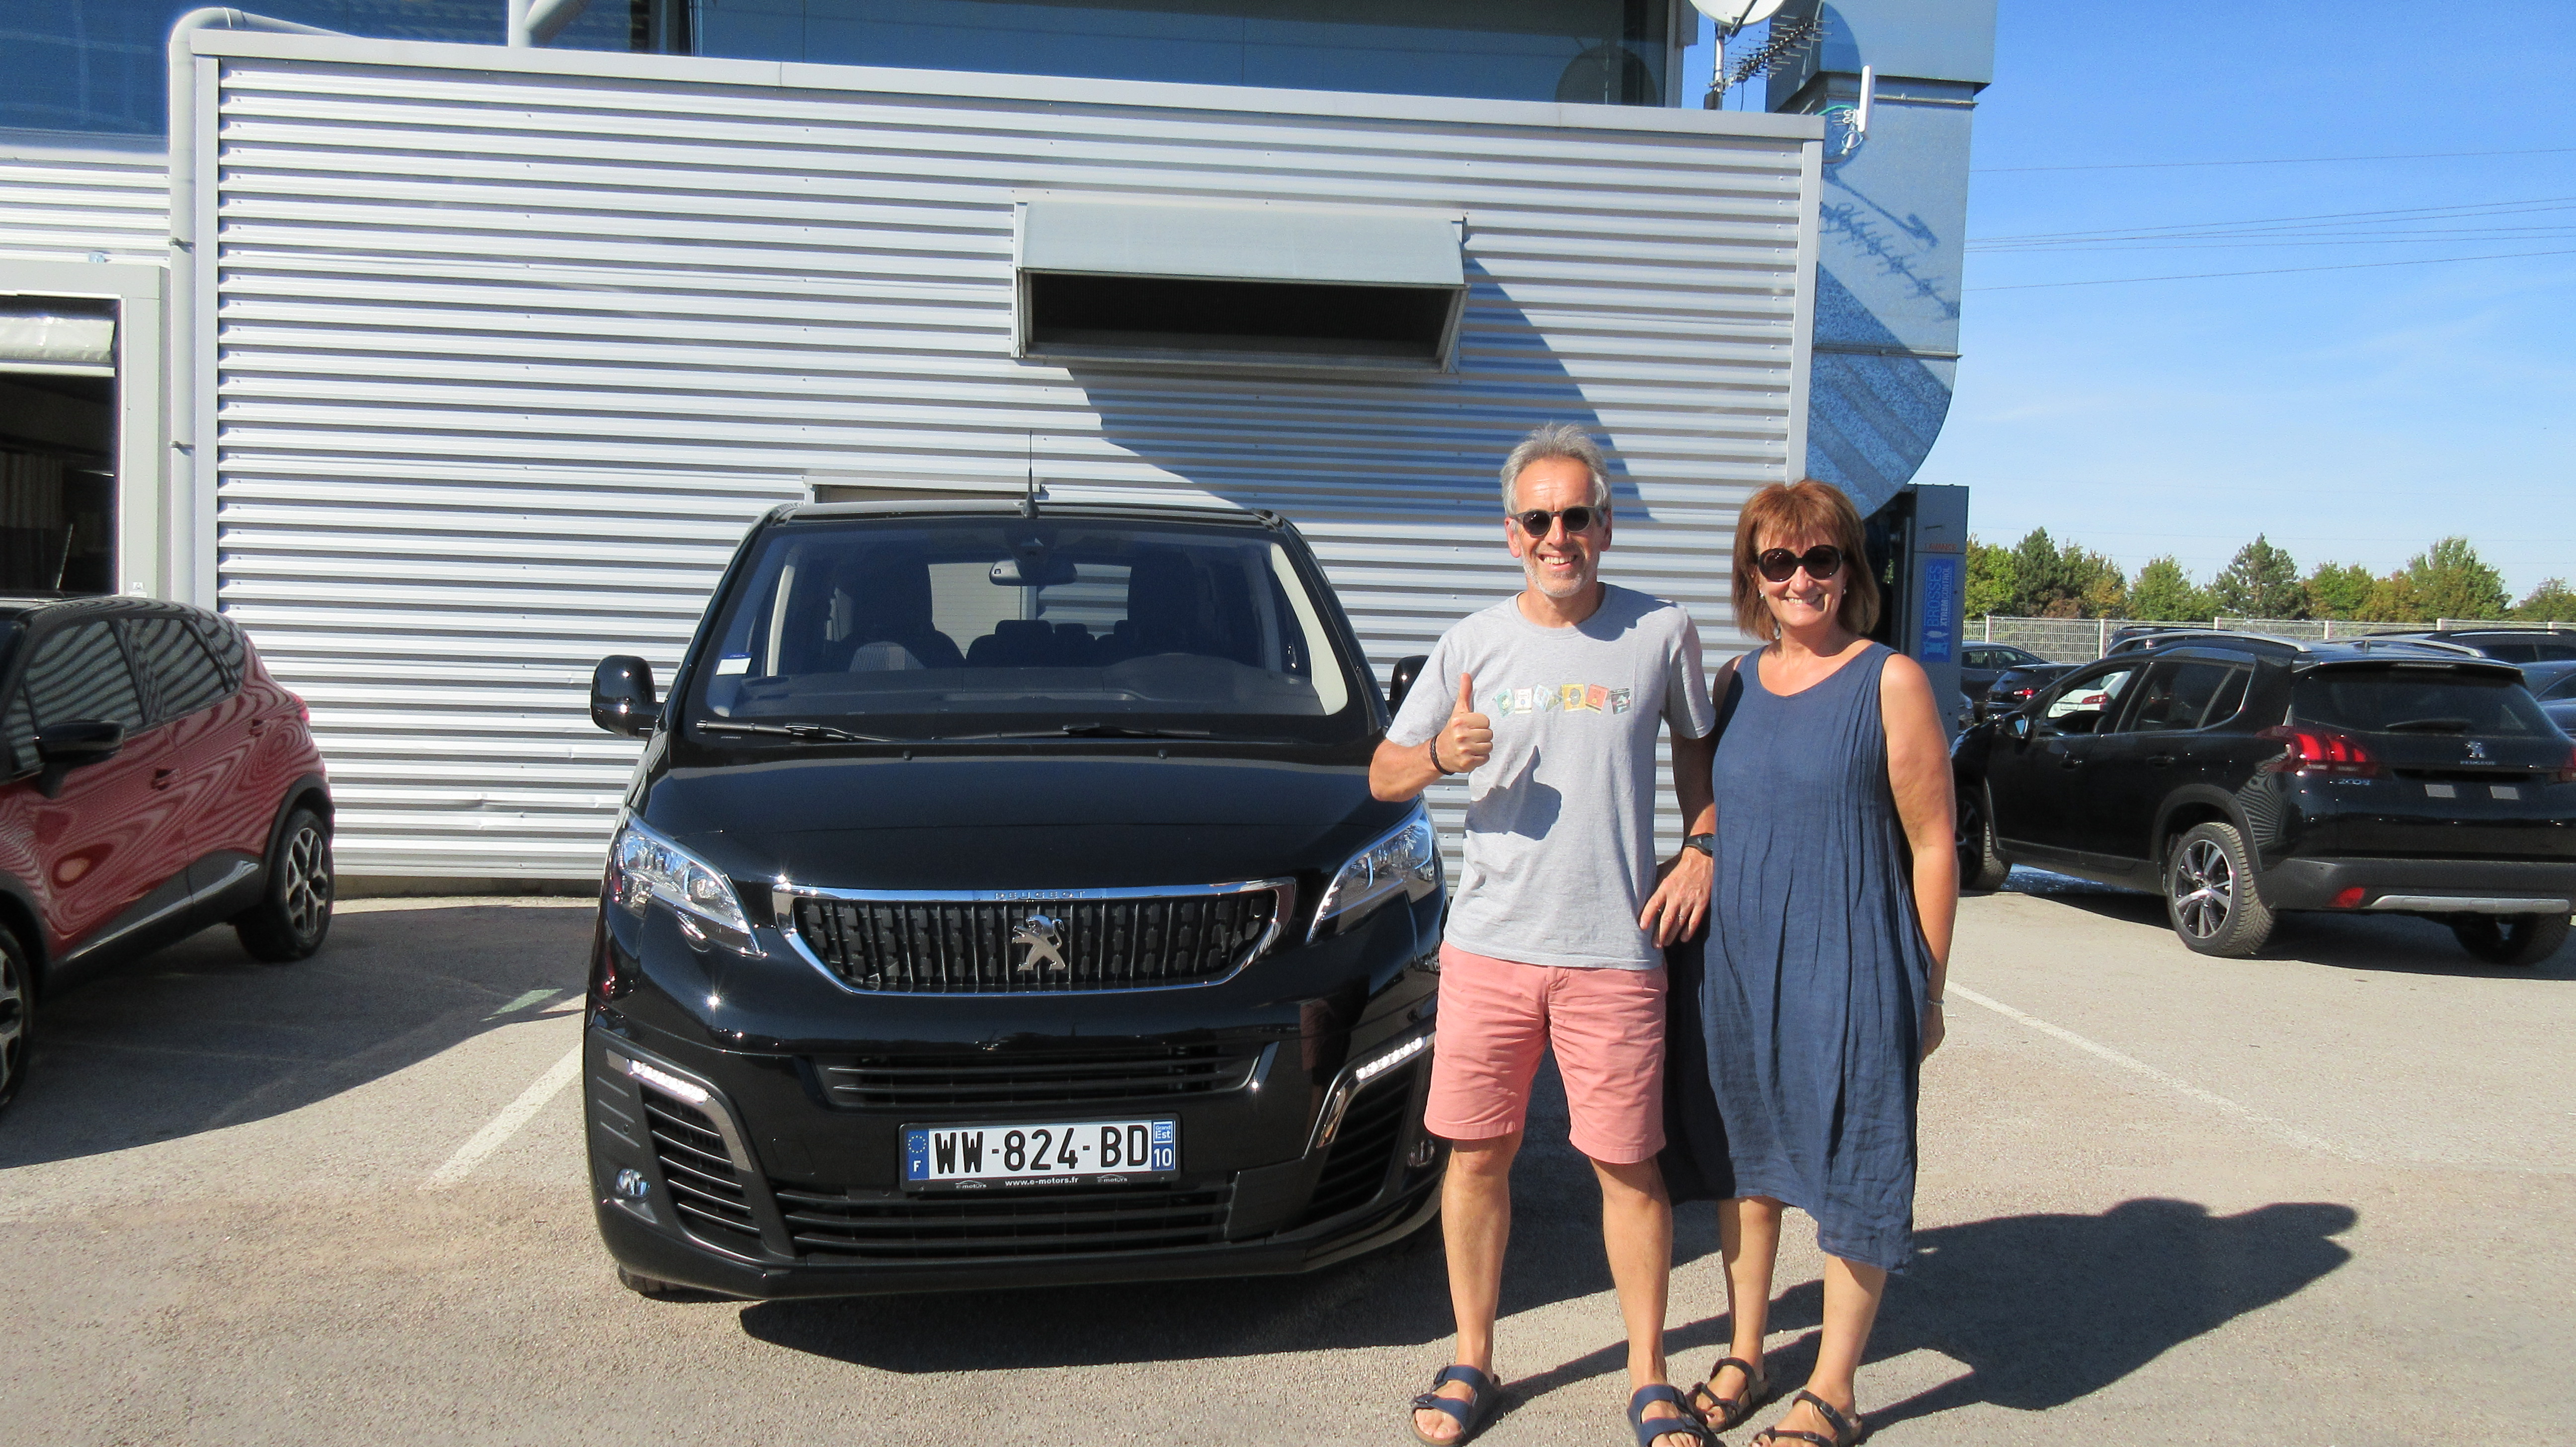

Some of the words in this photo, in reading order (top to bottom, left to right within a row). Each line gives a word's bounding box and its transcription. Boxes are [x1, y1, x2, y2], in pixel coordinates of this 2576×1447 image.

[1928, 565, 1942, 626] BROSSES
[994, 891, 1086, 899] PEUGEOT
[1155, 1130, 1171, 1139] Est
[1153, 1147, 1172, 1167] 10
[913, 1160, 921, 1172] F
[1005, 1176, 1079, 1187] www.e-motors.fr
